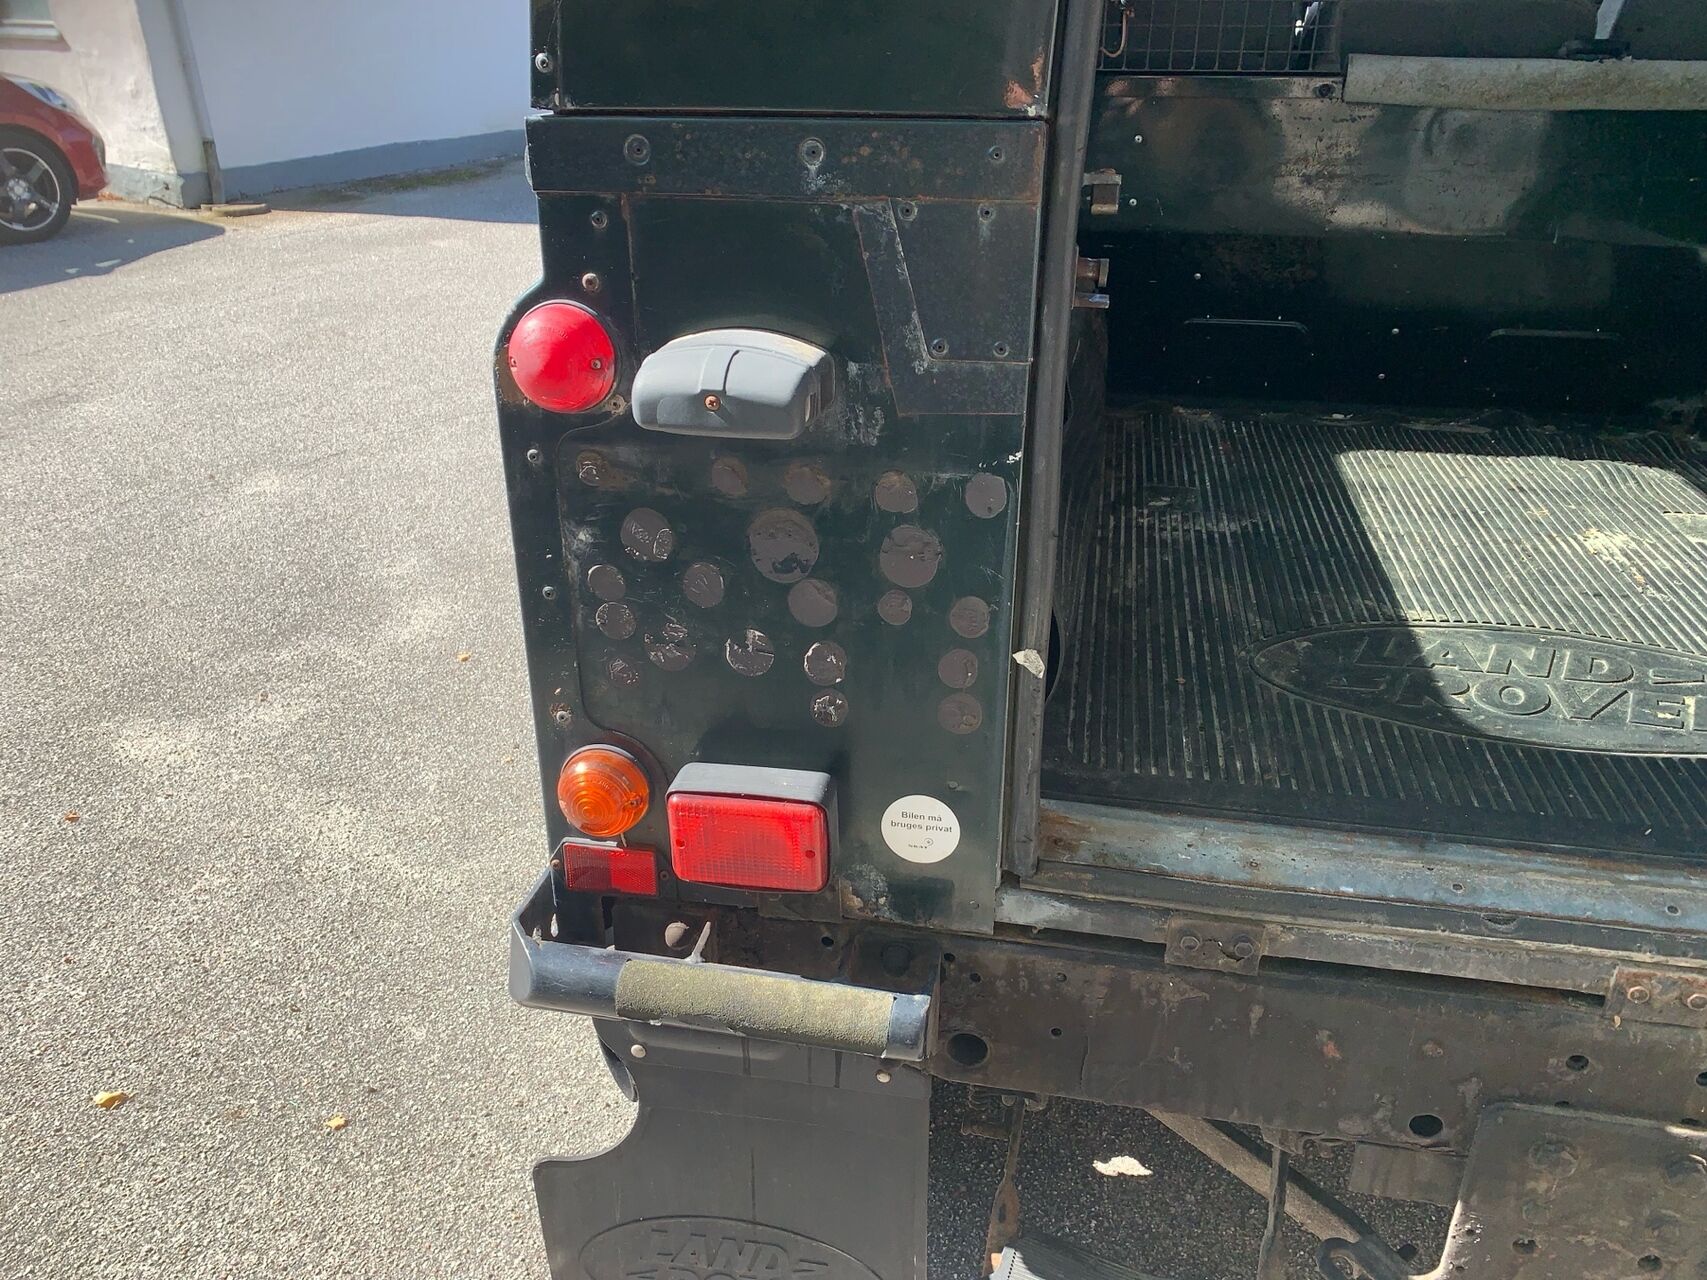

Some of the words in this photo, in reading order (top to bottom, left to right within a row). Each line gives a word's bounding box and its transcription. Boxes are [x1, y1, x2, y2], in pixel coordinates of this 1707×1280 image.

[1353, 636, 1636, 684] LAND
[1395, 672, 1707, 732] ROVE
[890, 820, 923, 830] bruges
[925, 824, 952, 833] privat
[901, 811, 926, 820] Bilen
[641, 1228, 790, 1273] LAND
